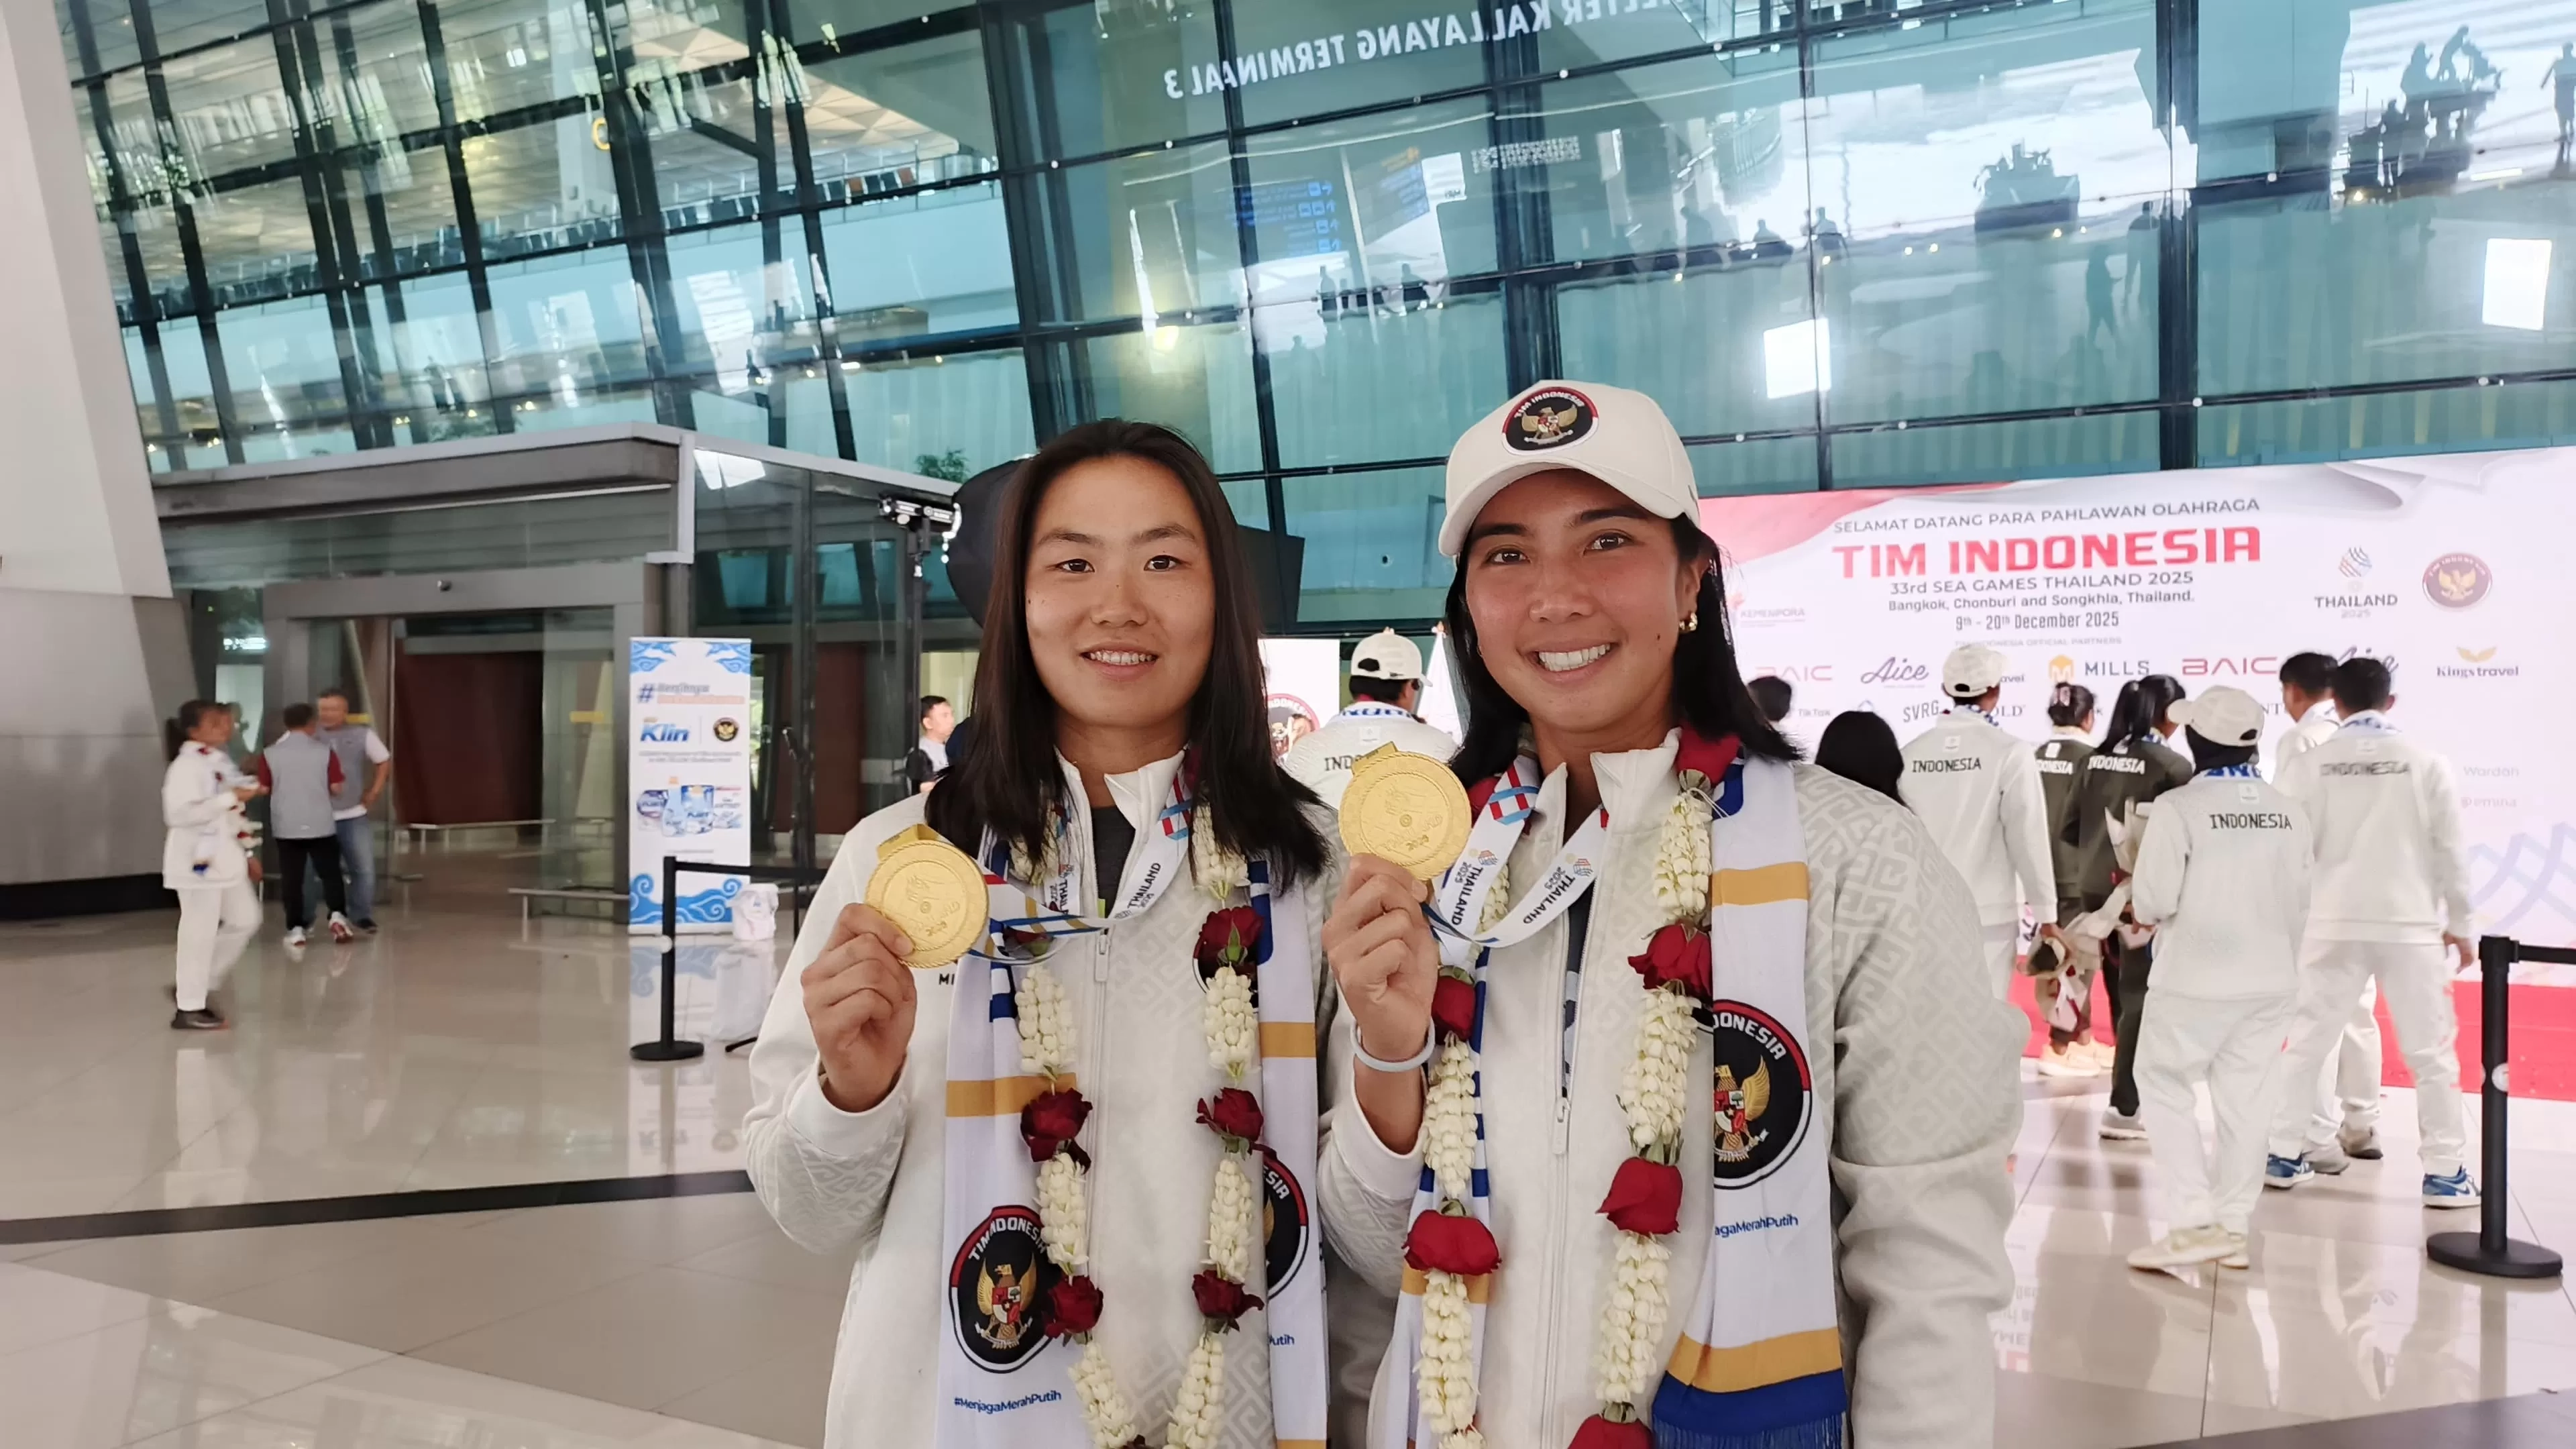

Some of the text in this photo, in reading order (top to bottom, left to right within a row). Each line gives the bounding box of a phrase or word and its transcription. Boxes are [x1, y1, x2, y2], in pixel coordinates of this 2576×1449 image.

[1514, 392, 1585, 418] TIM INDONESIA
[1833, 498, 2260, 533] SELAMAT DATANG PARA PAHLAWAN OLAHRAGA
[1832, 526, 2261, 578] TIM INDONESIA
[1890, 572, 2194, 594] 33rd SEA GAMES THAILAND 2025
[1889, 590, 2195, 612] Bangkok, Chonburi and Songkhla, Thailand.
[2314, 594, 2398, 608] THAILAND
[2015, 612, 2081, 629] December
[2086, 611, 2119, 627] 2025
[1860, 656, 1930, 684] Aice
[2084, 660, 2150, 676] MILLS
[2182, 656, 2278, 676] BAIC
[640, 723, 690, 742] Klin
[1912, 757, 1982, 773] INDONESIA
[2210, 813, 2293, 831] INDONESIA
[1128, 863, 1162, 909] THAILAND
[1452, 866, 1484, 926] THAILAND
[1523, 875, 1576, 924] THAILAND
[968, 1230, 990, 1261] TIM
[954, 1390, 1062, 1415] #MenjagaMerahPutih
